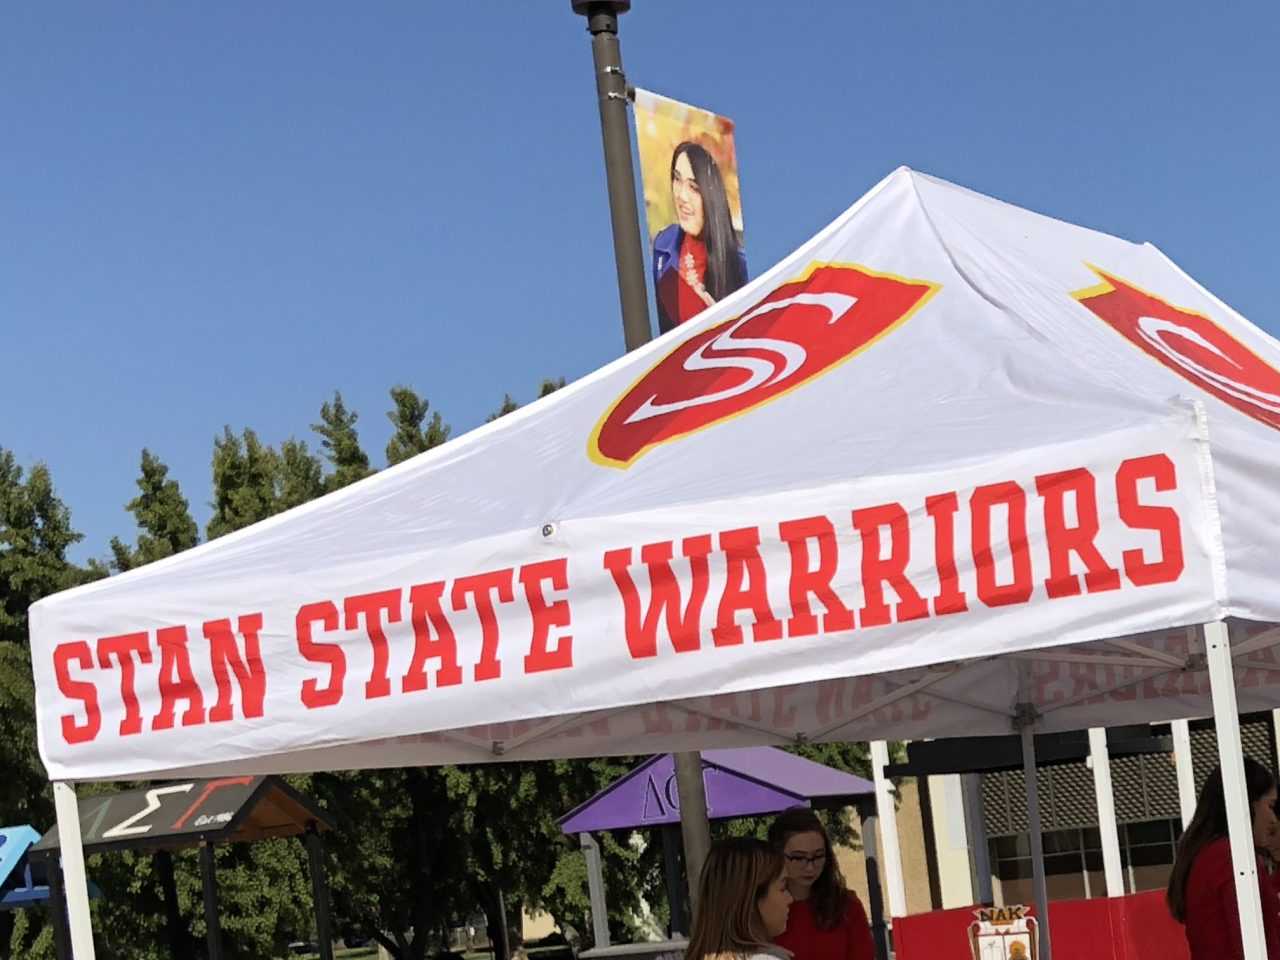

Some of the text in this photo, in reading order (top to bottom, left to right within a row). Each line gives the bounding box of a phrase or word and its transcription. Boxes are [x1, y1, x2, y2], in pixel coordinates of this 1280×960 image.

[53, 455, 1184, 745] STAN STATE WARRIORS
[980, 908, 1022, 921] NAK
